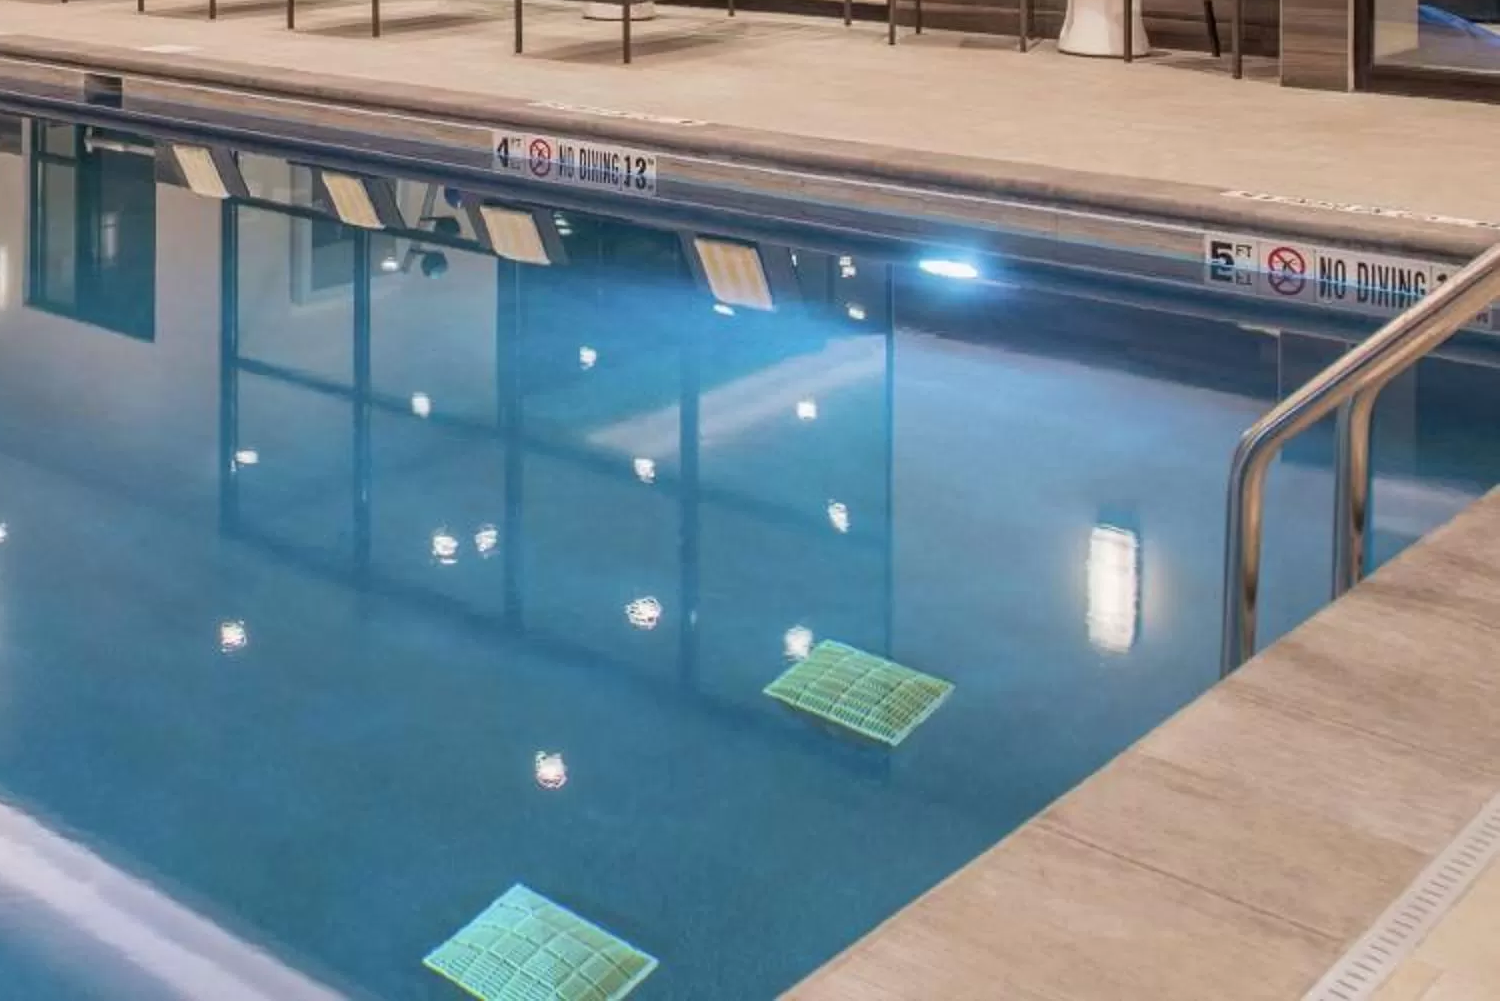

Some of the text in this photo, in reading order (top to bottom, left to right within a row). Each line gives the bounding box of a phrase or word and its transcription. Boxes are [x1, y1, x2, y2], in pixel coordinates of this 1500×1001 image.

[497, 137, 509, 160] 4
[1210, 240, 1426, 299] 5 FT NO DIVING
